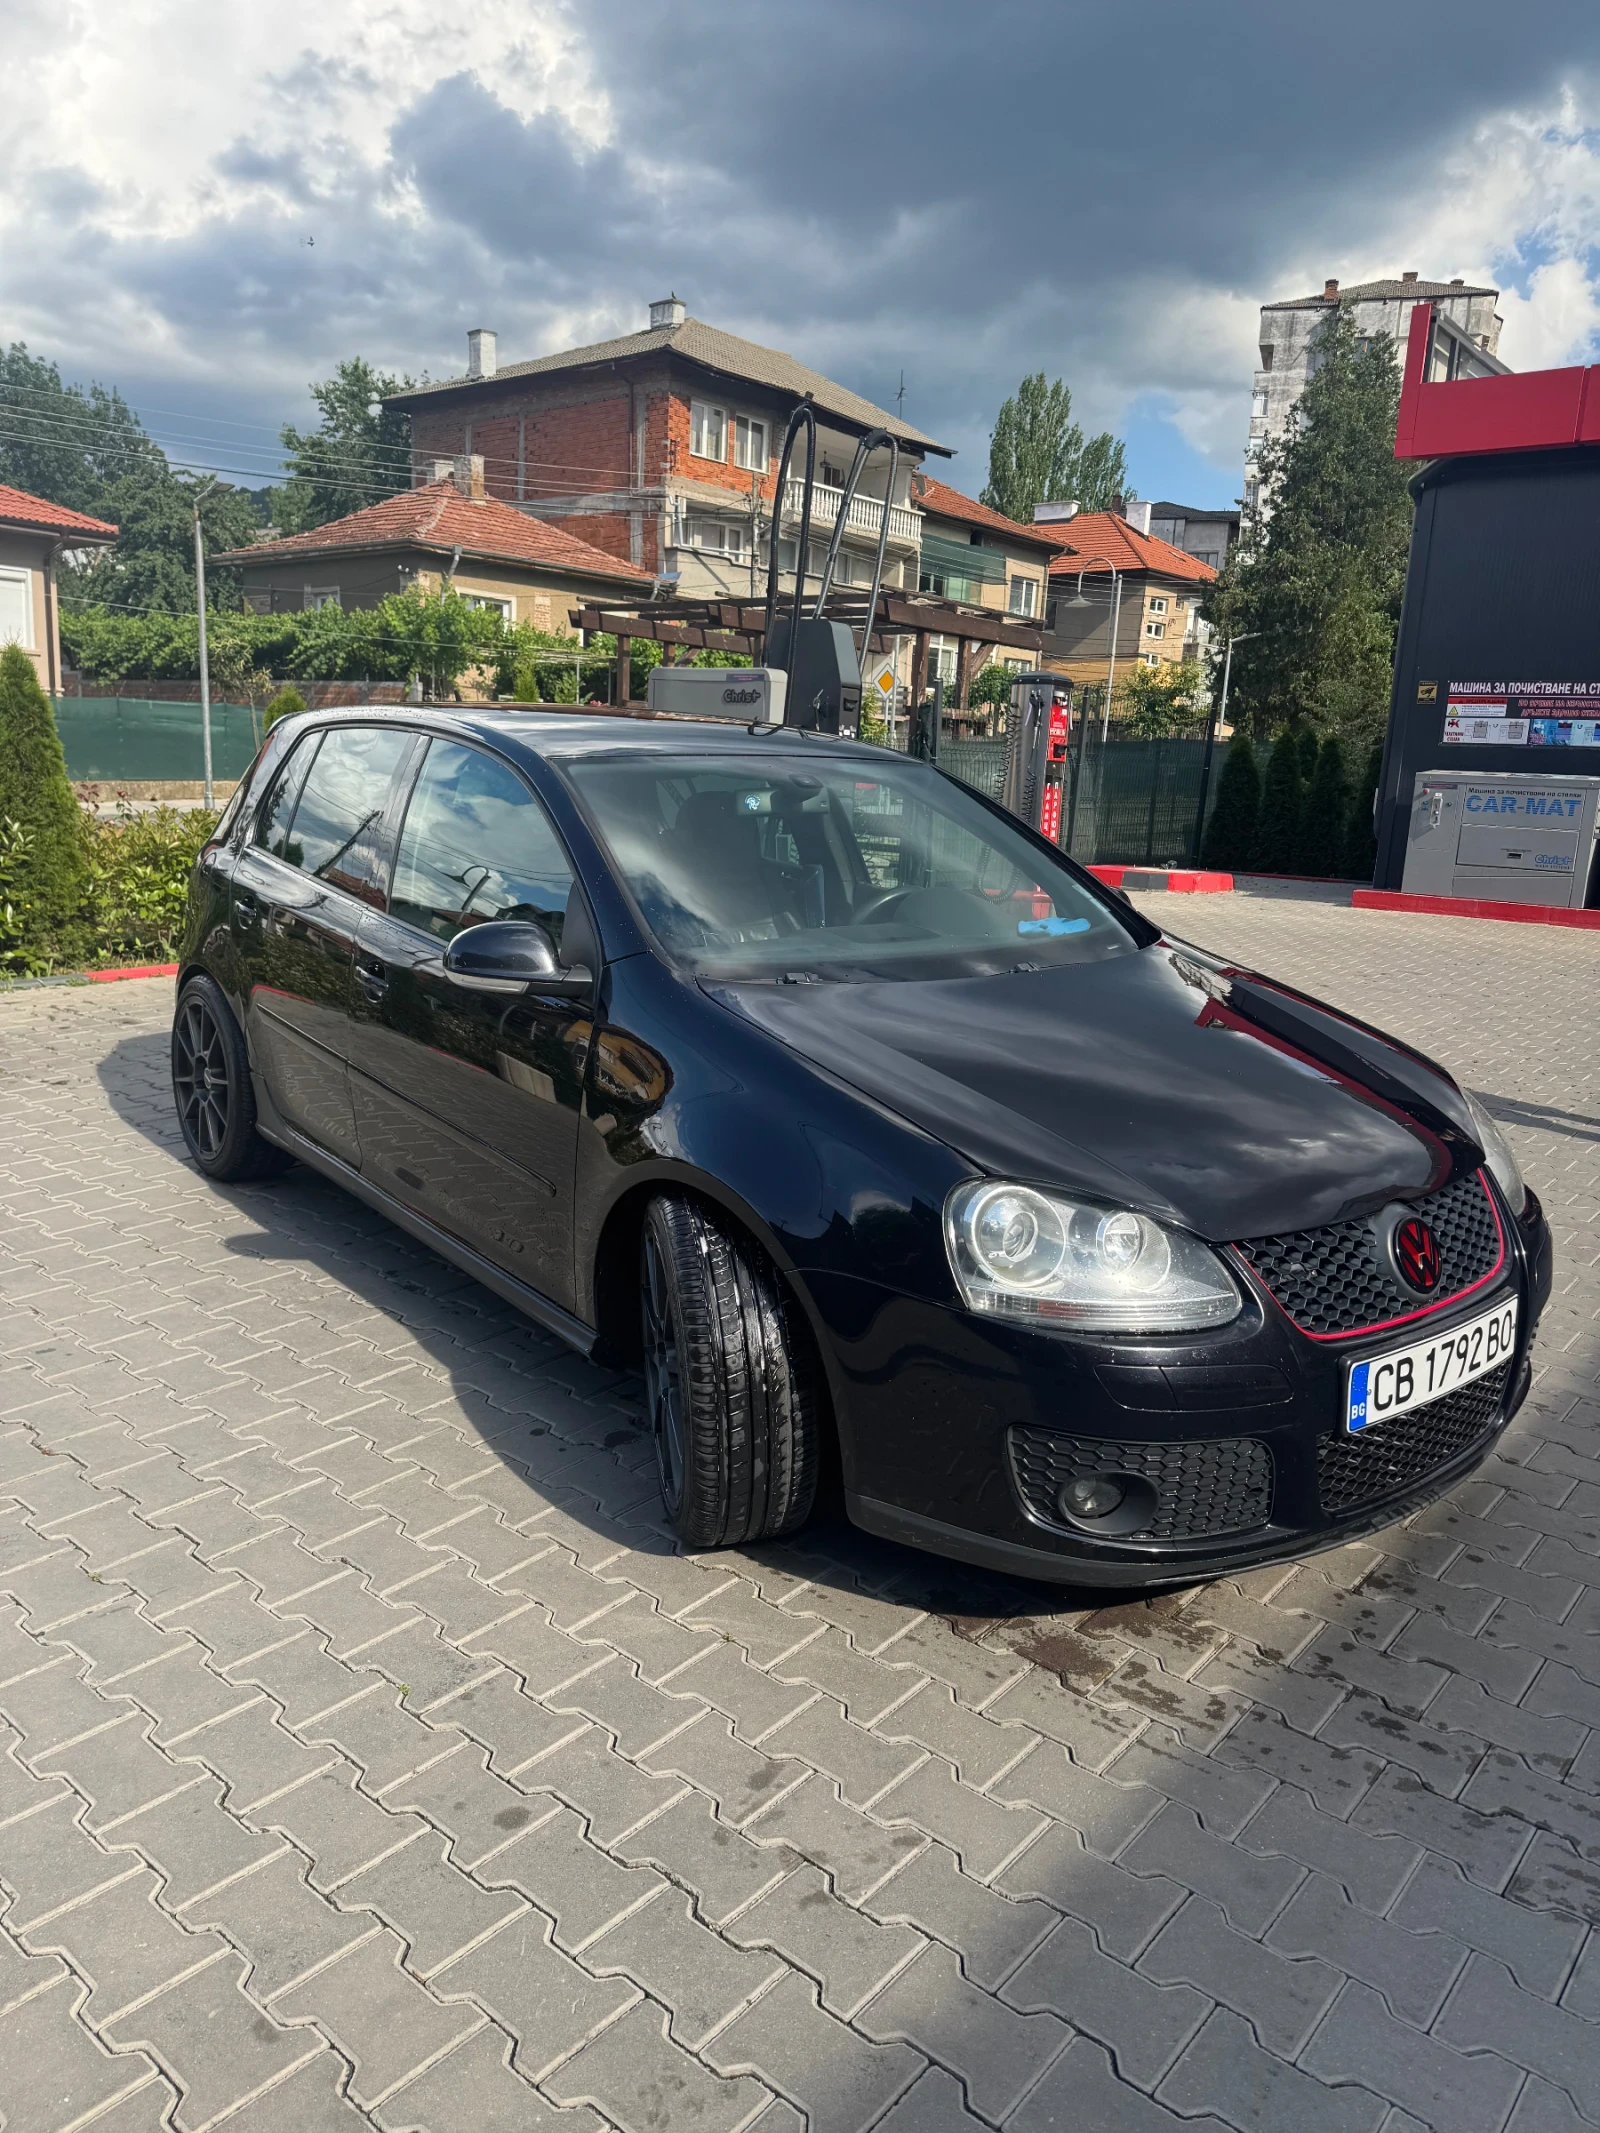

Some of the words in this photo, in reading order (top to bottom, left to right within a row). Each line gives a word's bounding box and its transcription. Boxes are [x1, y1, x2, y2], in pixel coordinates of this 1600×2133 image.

[723, 689, 761, 704] Christ
[1449, 682, 1492, 693] МАШИНА
[1493, 682, 1506, 693] ЗА
[1507, 682, 1572, 694] ПОЧИСТВАНЕ
[1572, 683, 1588, 694] НА
[1050, 781, 1059, 838] ПАРФЮМ
[1466, 795, 1582, 817] CAR-MAT
[1535, 853, 1573, 866] Christ
[1374, 1356, 1415, 1411] CB
[1426, 1326, 1483, 1393] 1792
[1486, 1309, 1513, 1363] BO
[1351, 1403, 1366, 1420] BG
